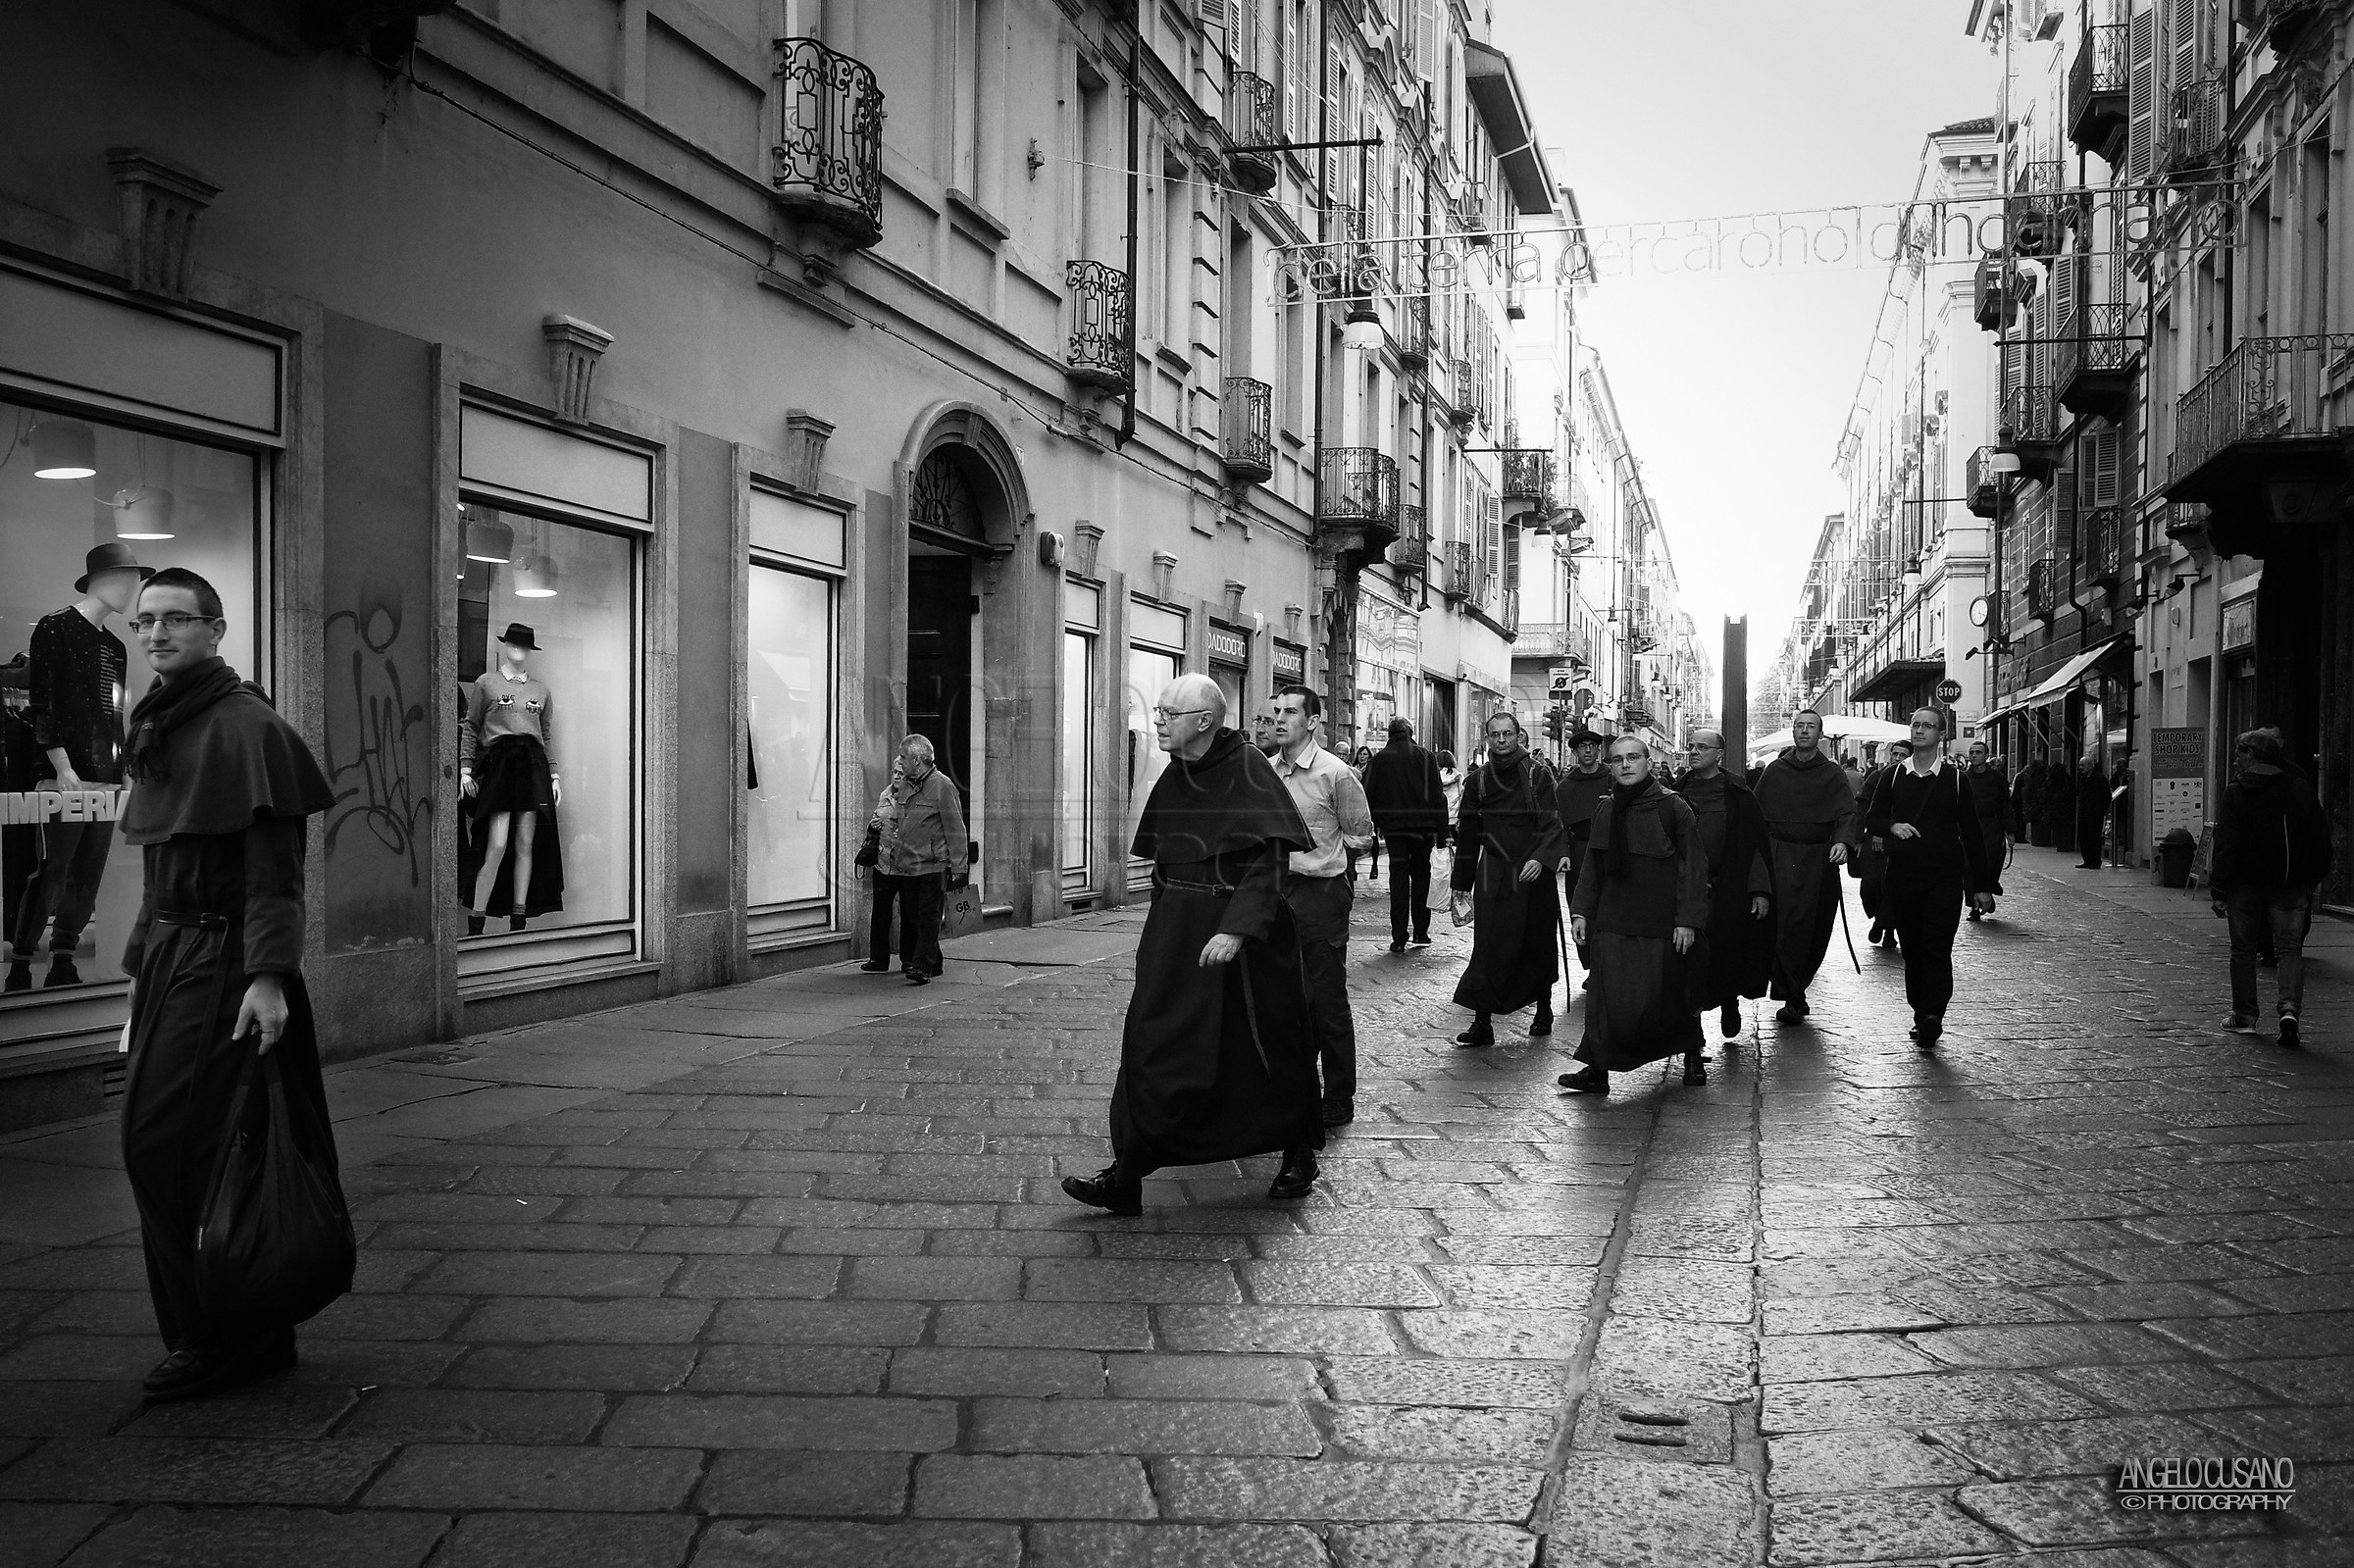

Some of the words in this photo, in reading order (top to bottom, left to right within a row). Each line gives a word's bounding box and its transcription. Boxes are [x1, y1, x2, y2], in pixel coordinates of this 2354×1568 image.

[1938, 686, 1961, 697] STOP
[2152, 732, 2204, 743] TEMPORARY
[2155, 744, 2178, 754] SHOP
[2180, 743, 2200, 754] KIDS
[956, 900, 971, 913] GB
